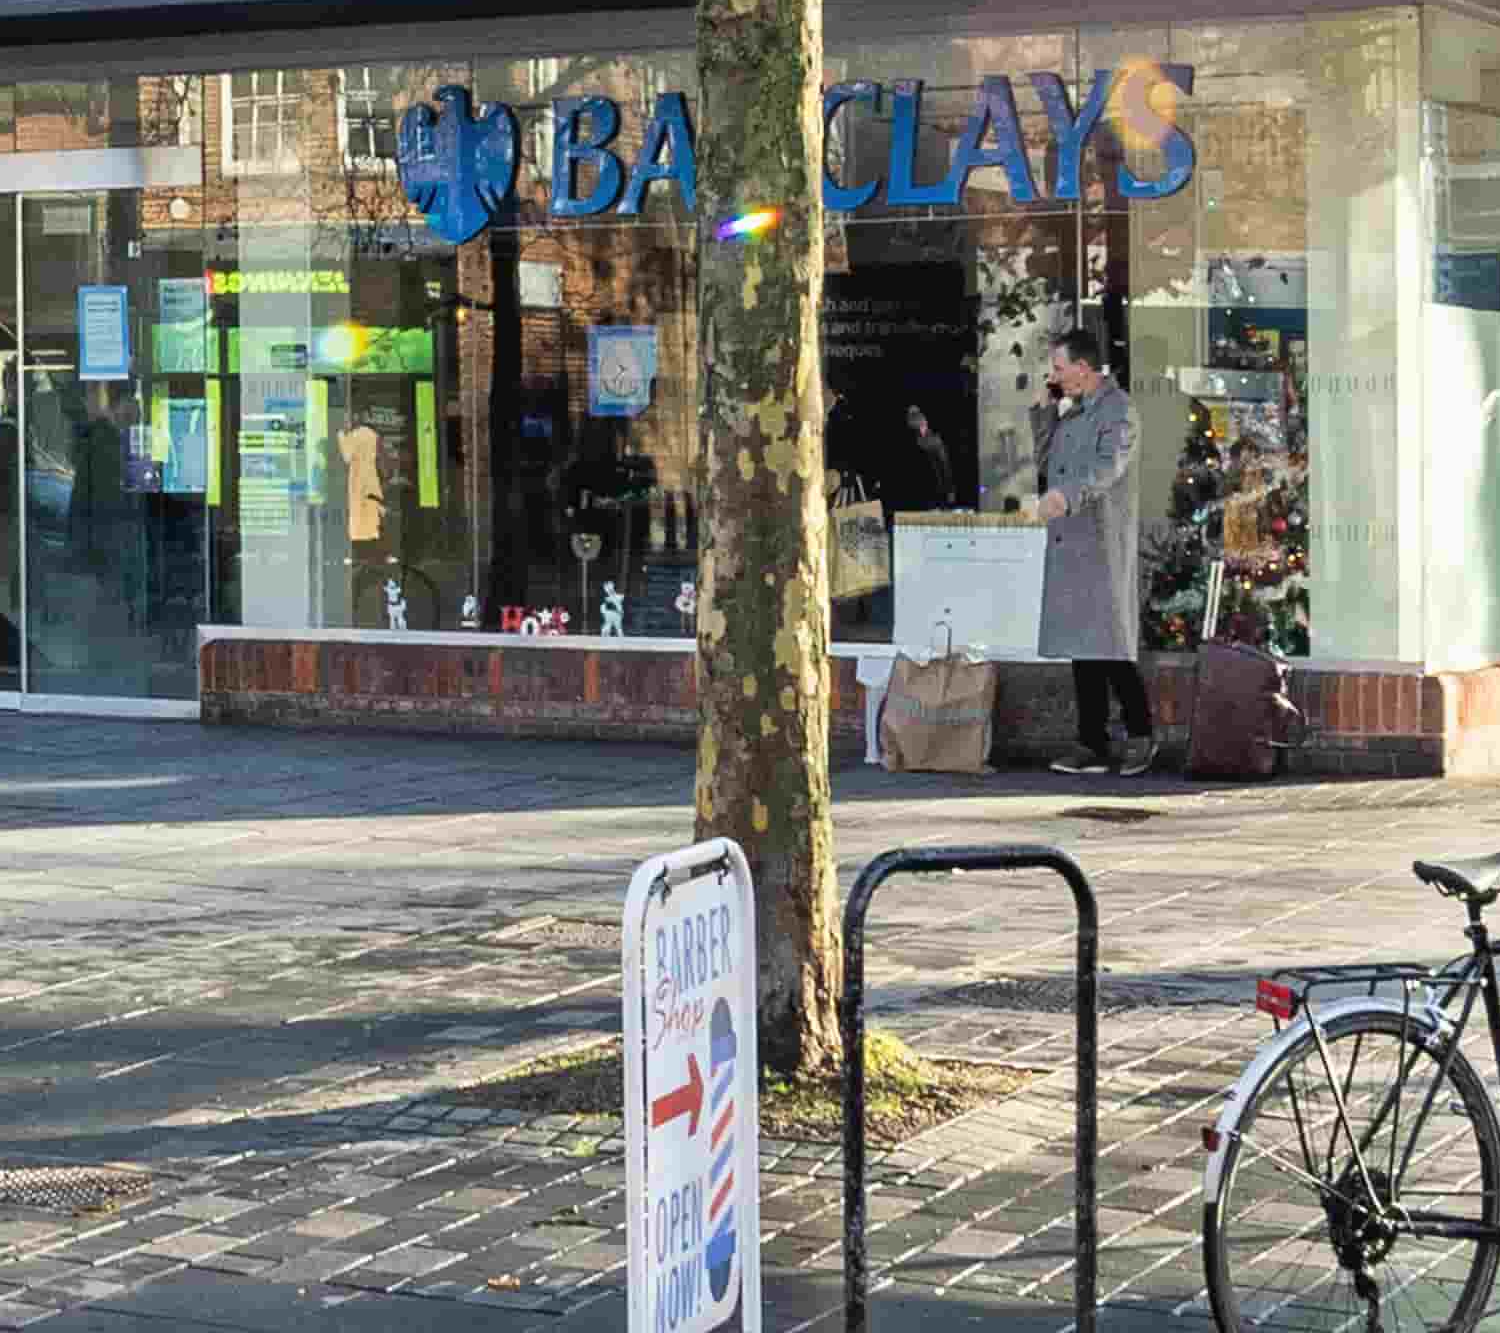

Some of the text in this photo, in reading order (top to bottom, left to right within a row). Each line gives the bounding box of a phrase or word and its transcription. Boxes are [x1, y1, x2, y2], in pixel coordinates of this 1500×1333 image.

[551, 62, 1196, 219] BACLAYS
[656, 903, 732, 993] BARBER
[652, 976, 706, 1051] Shop
[656, 1176, 703, 1264] OPEN
[656, 1252, 703, 1333] NOW!
